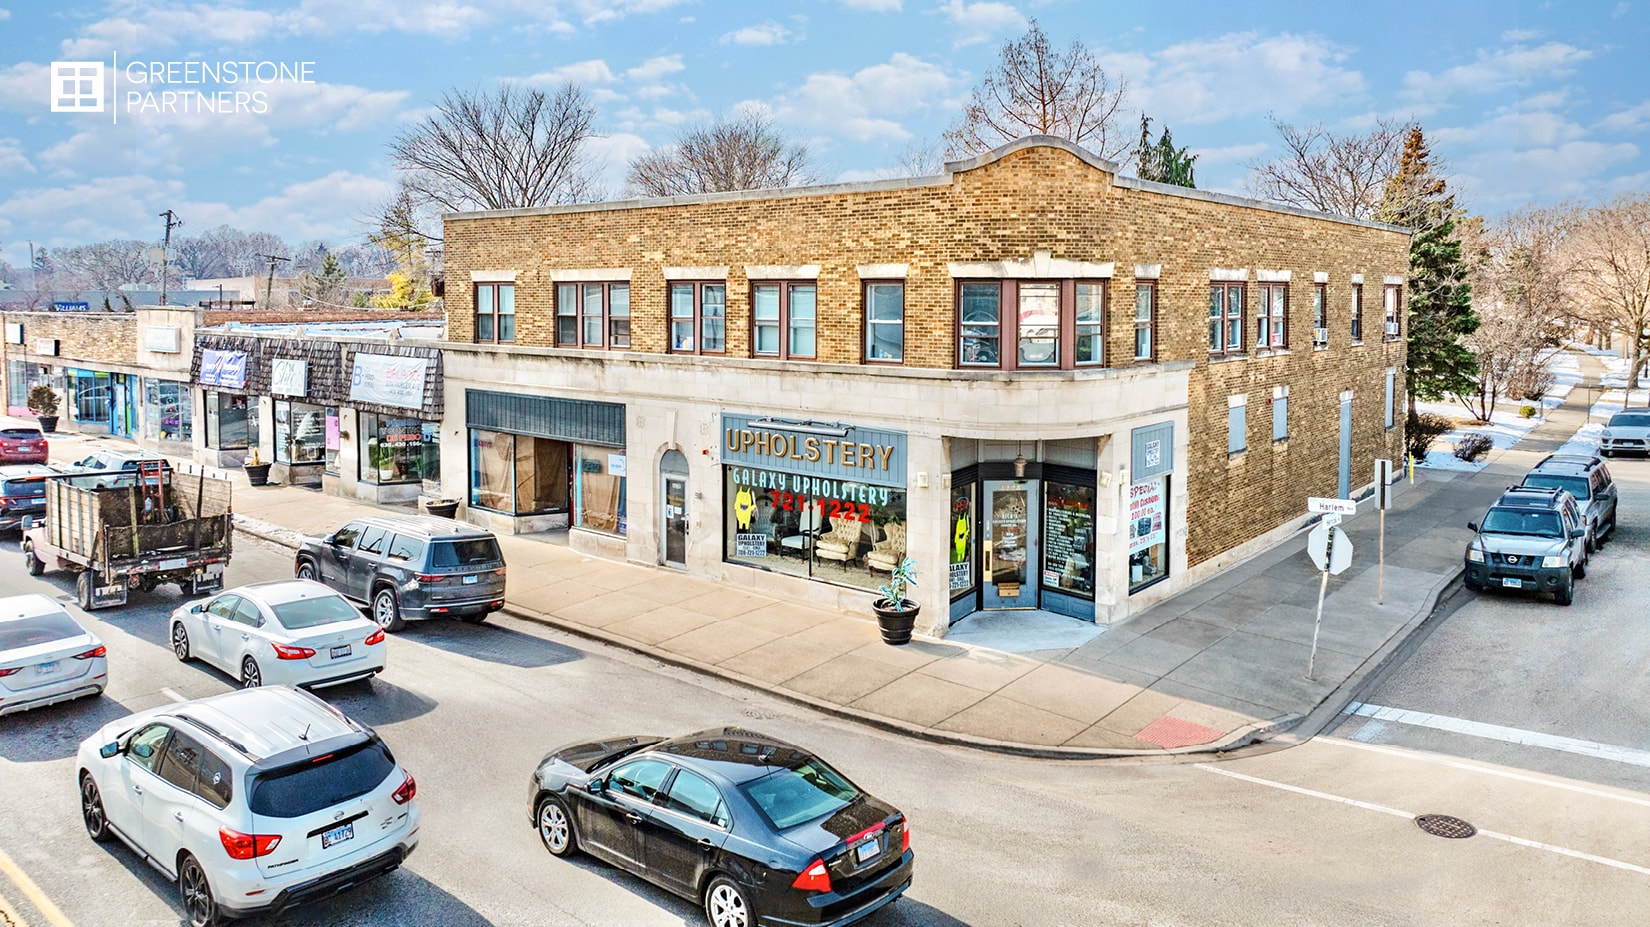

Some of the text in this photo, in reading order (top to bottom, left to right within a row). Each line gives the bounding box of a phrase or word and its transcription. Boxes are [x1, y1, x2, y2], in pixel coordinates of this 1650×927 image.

[727, 428, 894, 470] UPHOLSTERY
[733, 467, 888, 506] GALAXY UPHOLSTERY
[1319, 502, 1344, 512] Harlem
[949, 563, 969, 572] ALAXY
